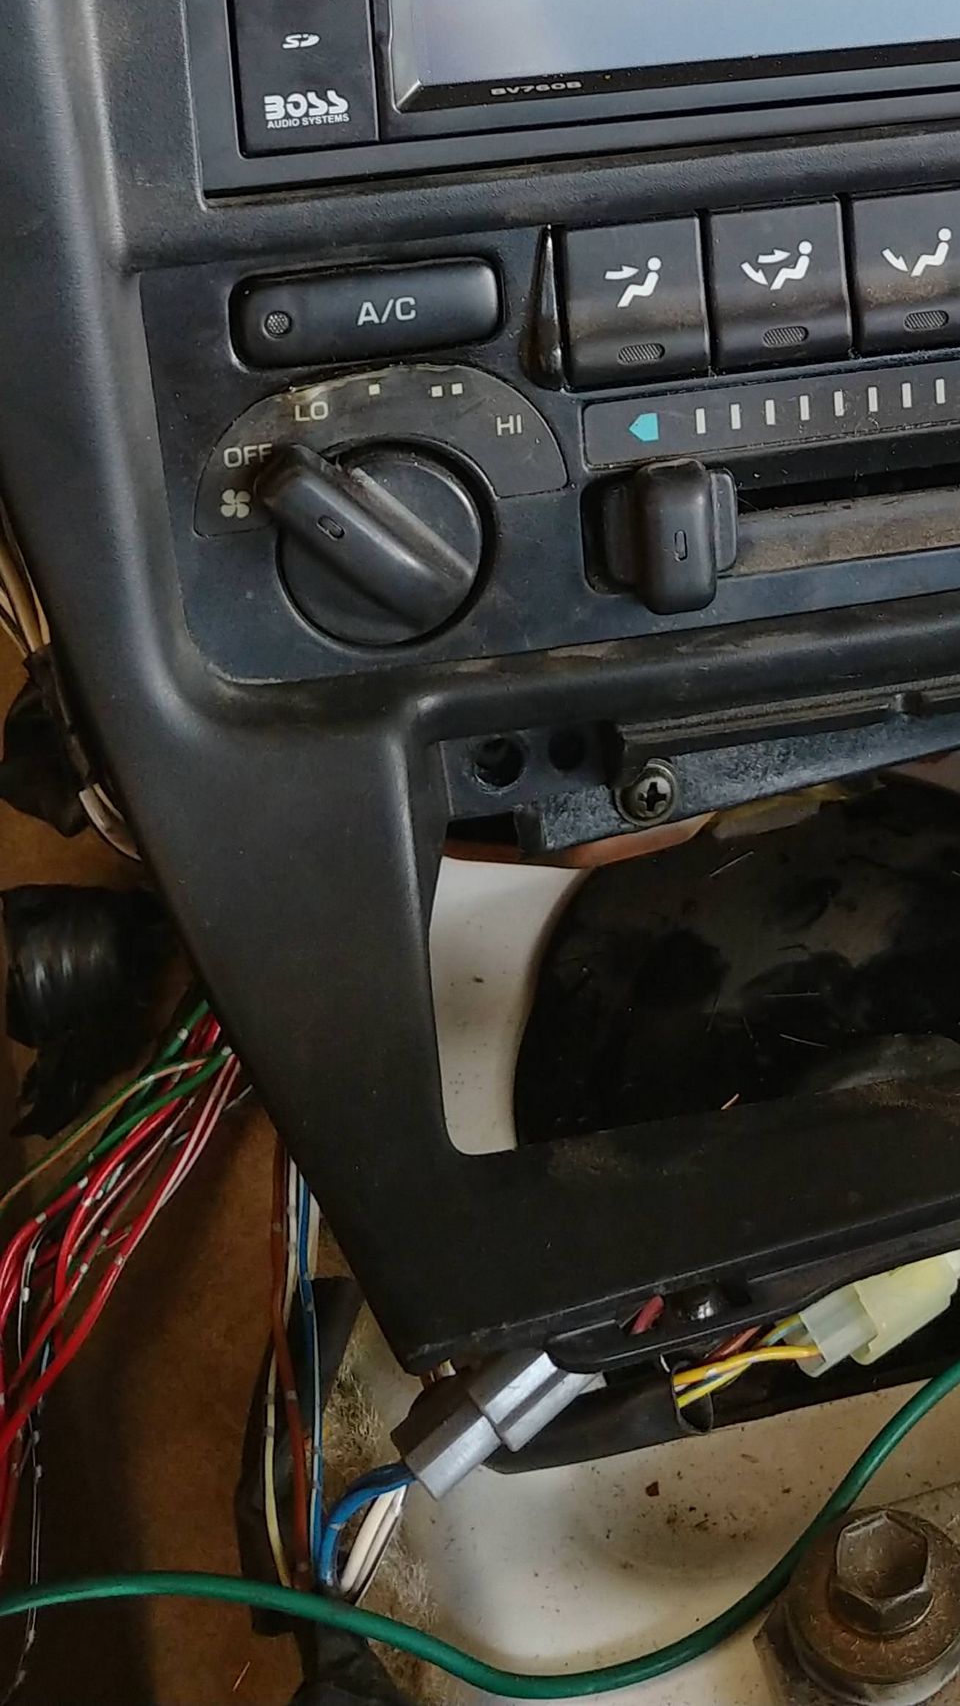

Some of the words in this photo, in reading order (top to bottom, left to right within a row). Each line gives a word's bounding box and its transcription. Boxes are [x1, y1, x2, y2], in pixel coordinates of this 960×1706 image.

[264, 90, 348, 120] BOSS
[267, 118, 300, 129] AUDIO
[301, 113, 350, 126] SYSTEMS
[357, 296, 416, 326] A/C
[294, 401, 329, 422] LO
[496, 414, 523, 436] HI
[223, 444, 273, 469] OFF
